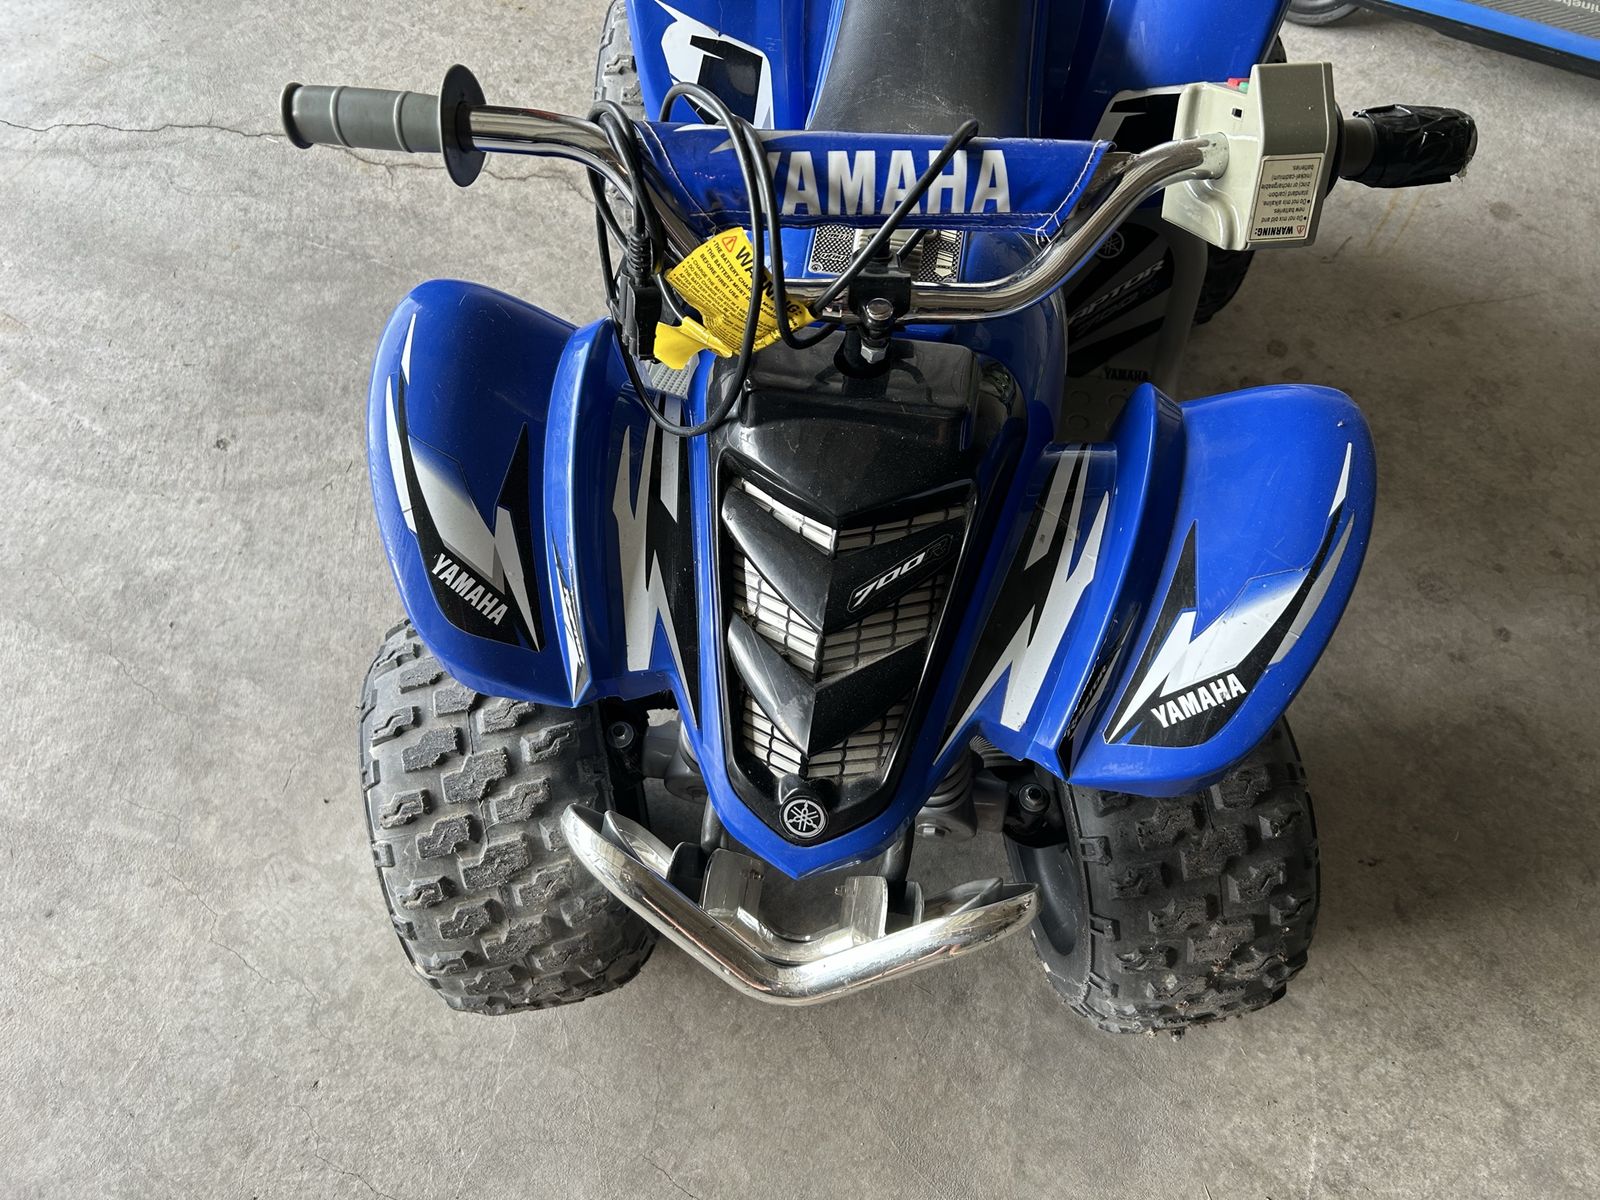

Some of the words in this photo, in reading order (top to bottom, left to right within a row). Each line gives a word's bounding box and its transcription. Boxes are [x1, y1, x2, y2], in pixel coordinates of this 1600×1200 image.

[1254, 226, 1293, 236] WARNING:
[700, 253, 717, 275] BEFORE
[715, 275, 729, 289] FIRST
[707, 248, 716, 260] THE
[714, 259, 733, 282] BATTERY
[733, 282, 747, 296] MUST
[714, 242, 722, 254] THE
[721, 253, 739, 276] BATTERY
[693, 260, 707, 277] CHARGE
[714, 286, 731, 302] BATTERY
[701, 280, 717, 296] CHARGE
[1068, 258, 1164, 326] APTOR
[1104, 367, 1150, 381] YAMAHA
[432, 552, 508, 626] YAMAHA
[1150, 673, 1247, 728] YAMAHA
